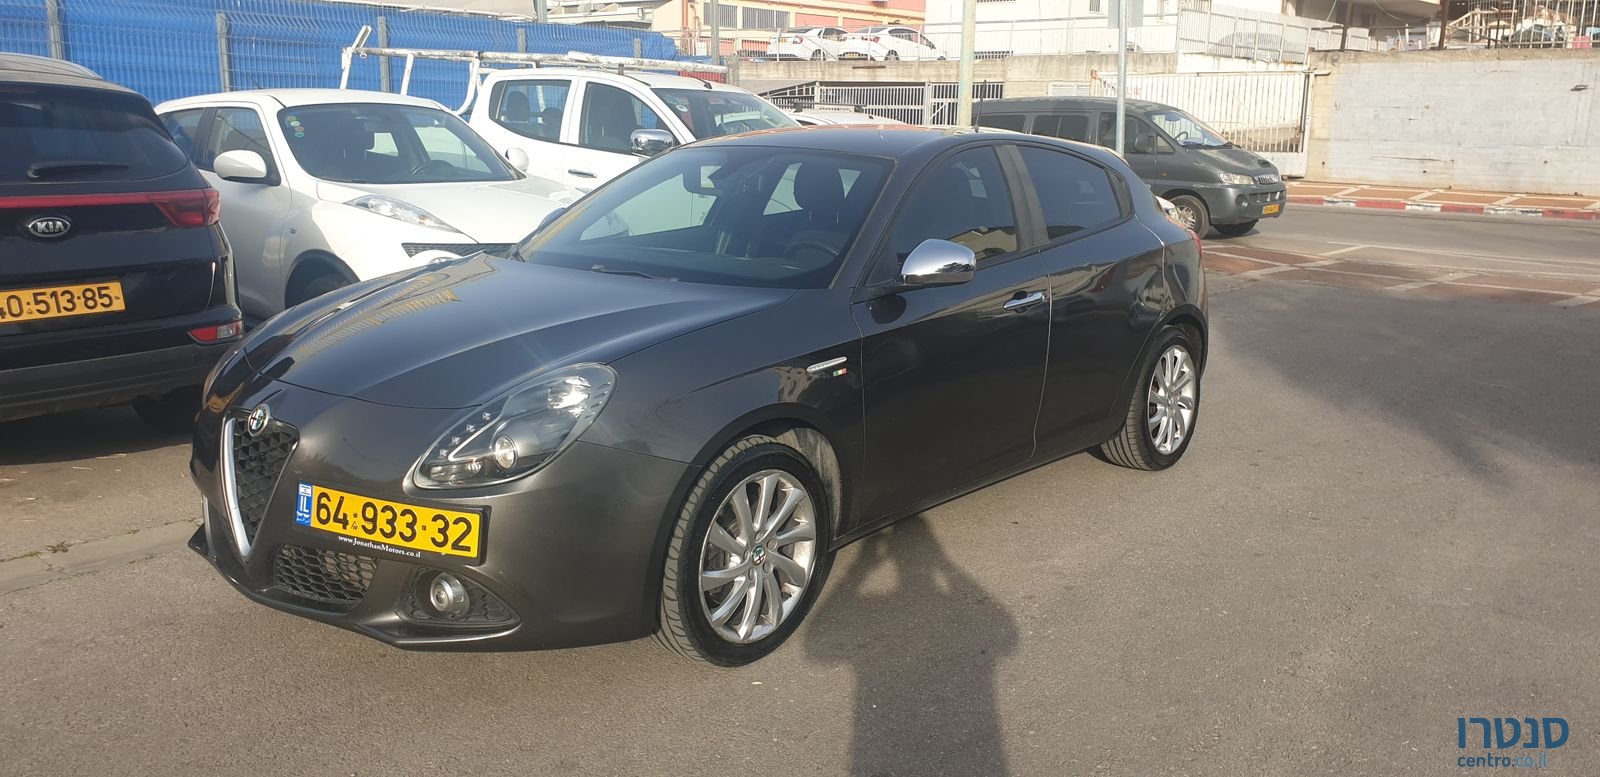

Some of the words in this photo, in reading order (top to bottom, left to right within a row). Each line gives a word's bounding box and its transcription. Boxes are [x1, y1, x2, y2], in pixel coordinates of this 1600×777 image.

[36, 221, 66, 233] KIA
[300, 495, 310, 513] IL
[338, 536, 421, 558] www.JonathanMotors.co.il
